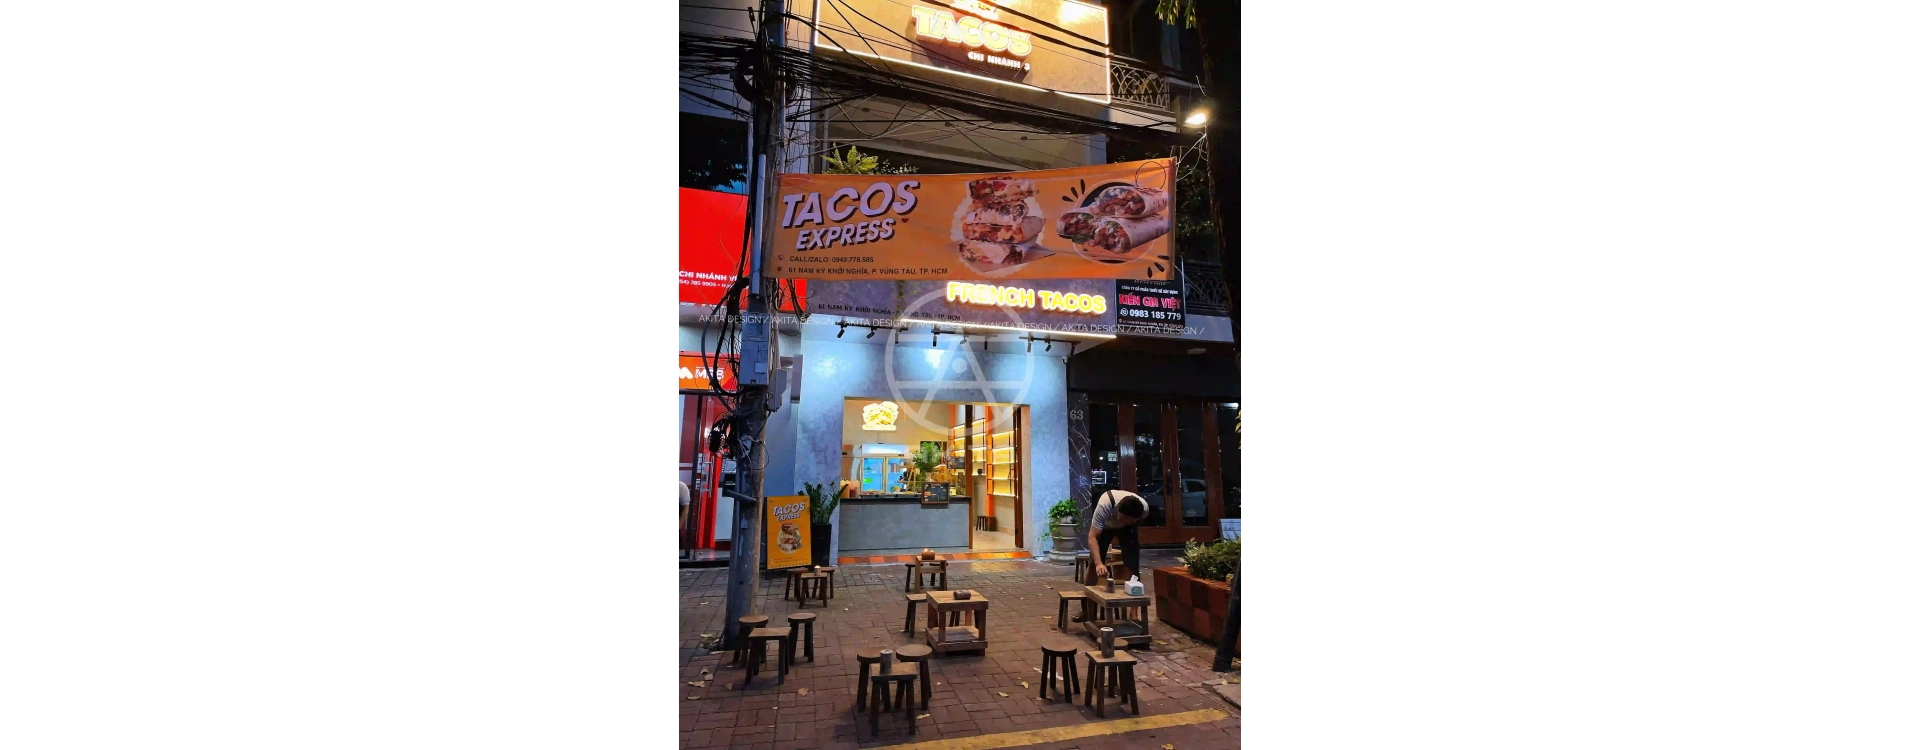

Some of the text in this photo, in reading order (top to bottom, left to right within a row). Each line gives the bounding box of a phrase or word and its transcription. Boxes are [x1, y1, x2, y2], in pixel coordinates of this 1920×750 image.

[912, 5, 1032, 56] TACOS
[968, 51, 1030, 70] CHI NHÁNH 3
[781, 180, 920, 228] TACOS
[795, 217, 897, 250] EXPRESS
[696, 272, 727, 281] NHÁNH
[947, 282, 1107, 315] FRENCH TACOS
[1142, 296, 1159, 307] GIA
[1161, 296, 1181, 311] VIỆT
[1130, 309, 1181, 320] 0983 185 779
[1070, 410, 1083, 420] 63
[773, 502, 805, 516] TACOS
[777, 513, 801, 522] EXPRESS
